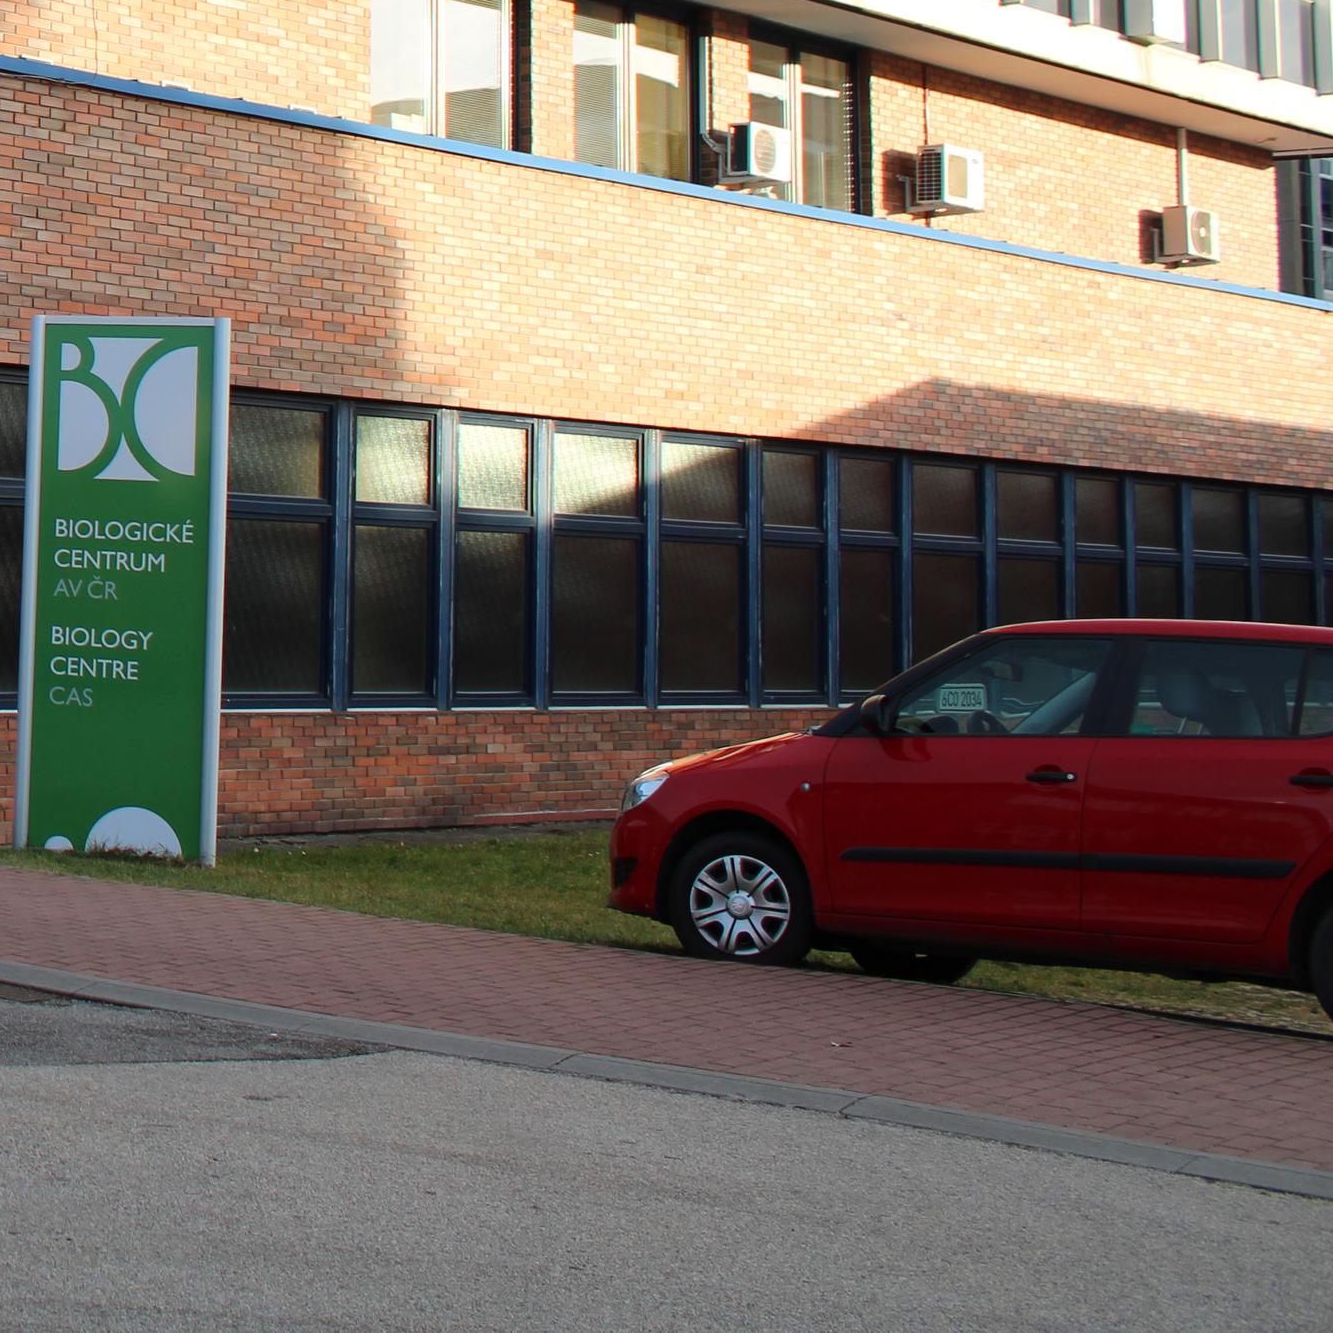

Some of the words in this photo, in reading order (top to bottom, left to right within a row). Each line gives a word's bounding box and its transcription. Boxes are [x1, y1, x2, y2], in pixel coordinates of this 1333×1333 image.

[55, 518, 194, 543] BIOLOGICKÉ
[54, 548, 166, 573] CENTRUM
[53, 578, 83, 598] AV
[87, 575, 118, 600] ČR
[51, 626, 153, 651] BIOLOGY
[50, 656, 139, 680] CENTRE
[49, 686, 93, 707] CAS
[961, 691, 982, 707] 2034
